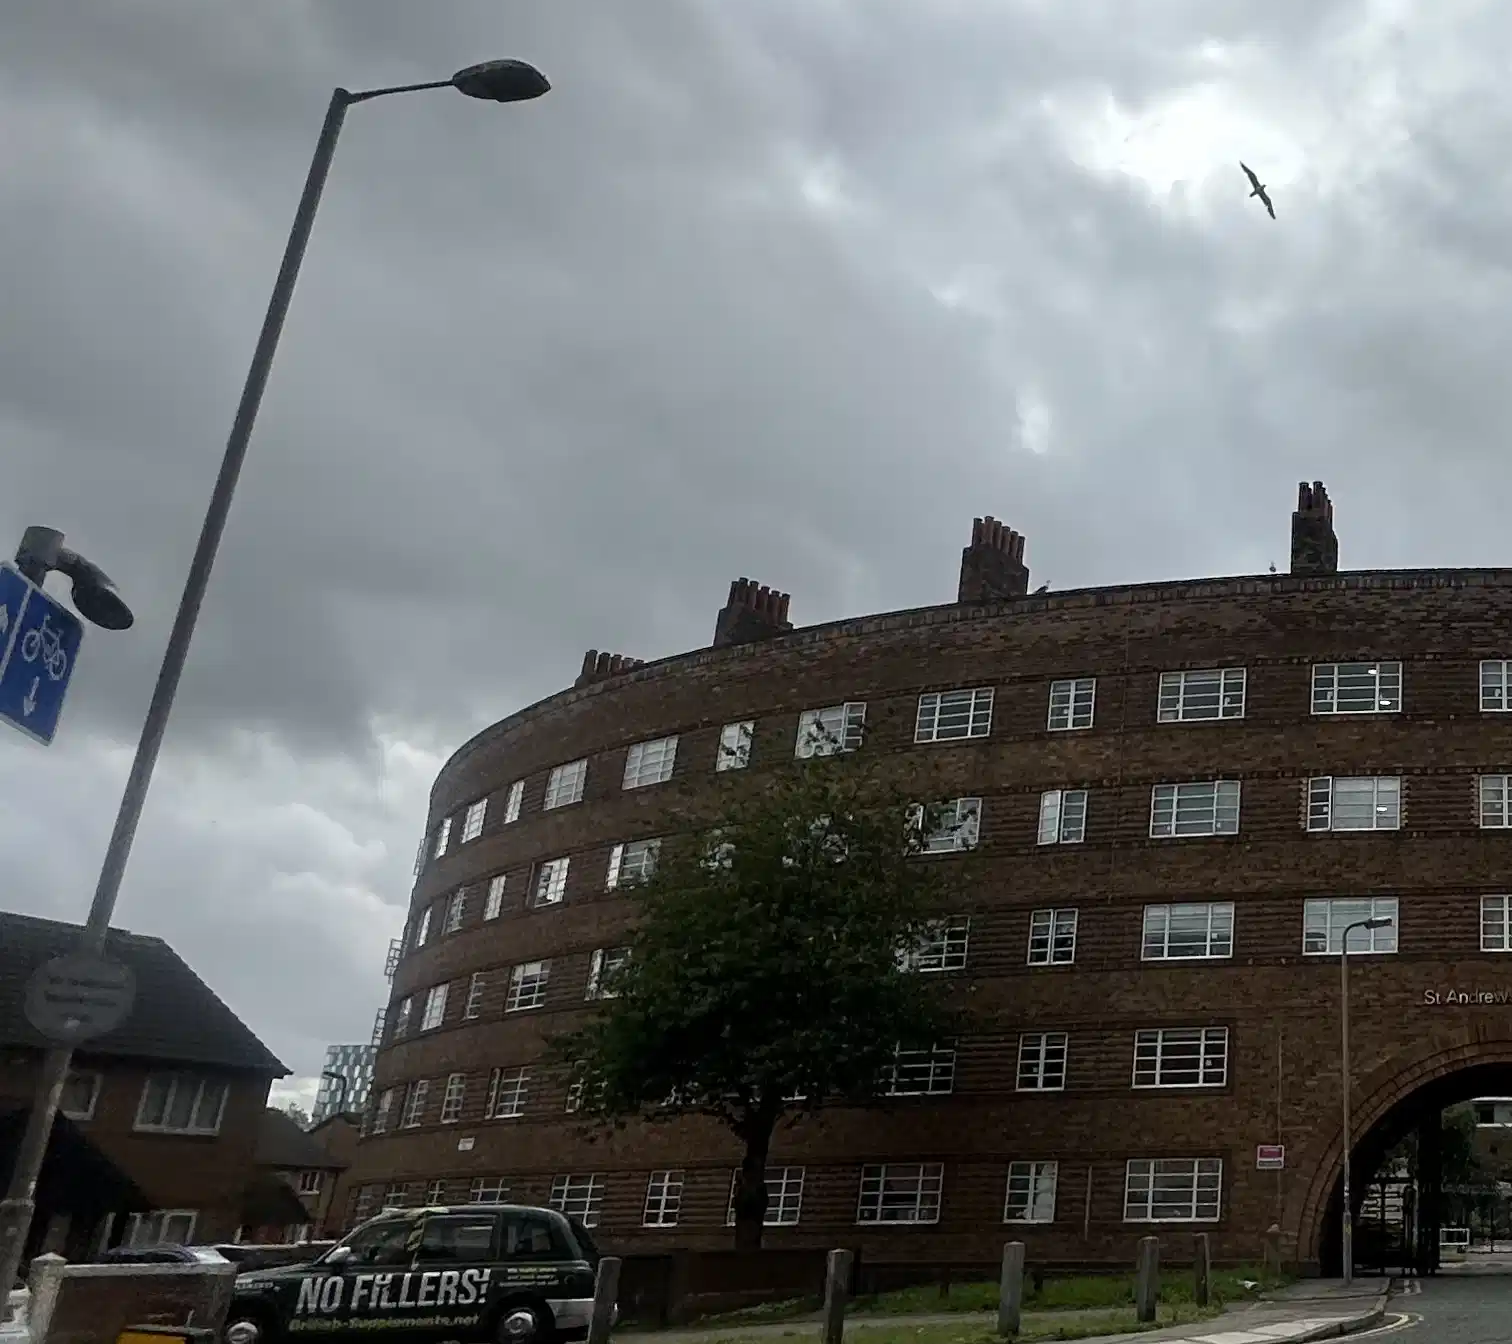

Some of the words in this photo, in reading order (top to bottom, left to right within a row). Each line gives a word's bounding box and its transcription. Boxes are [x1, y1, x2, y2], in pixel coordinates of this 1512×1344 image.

[1423, 989, 1441, 1005] St
[295, 1274, 345, 1314] NO
[349, 1267, 492, 1310] FILLERS!
